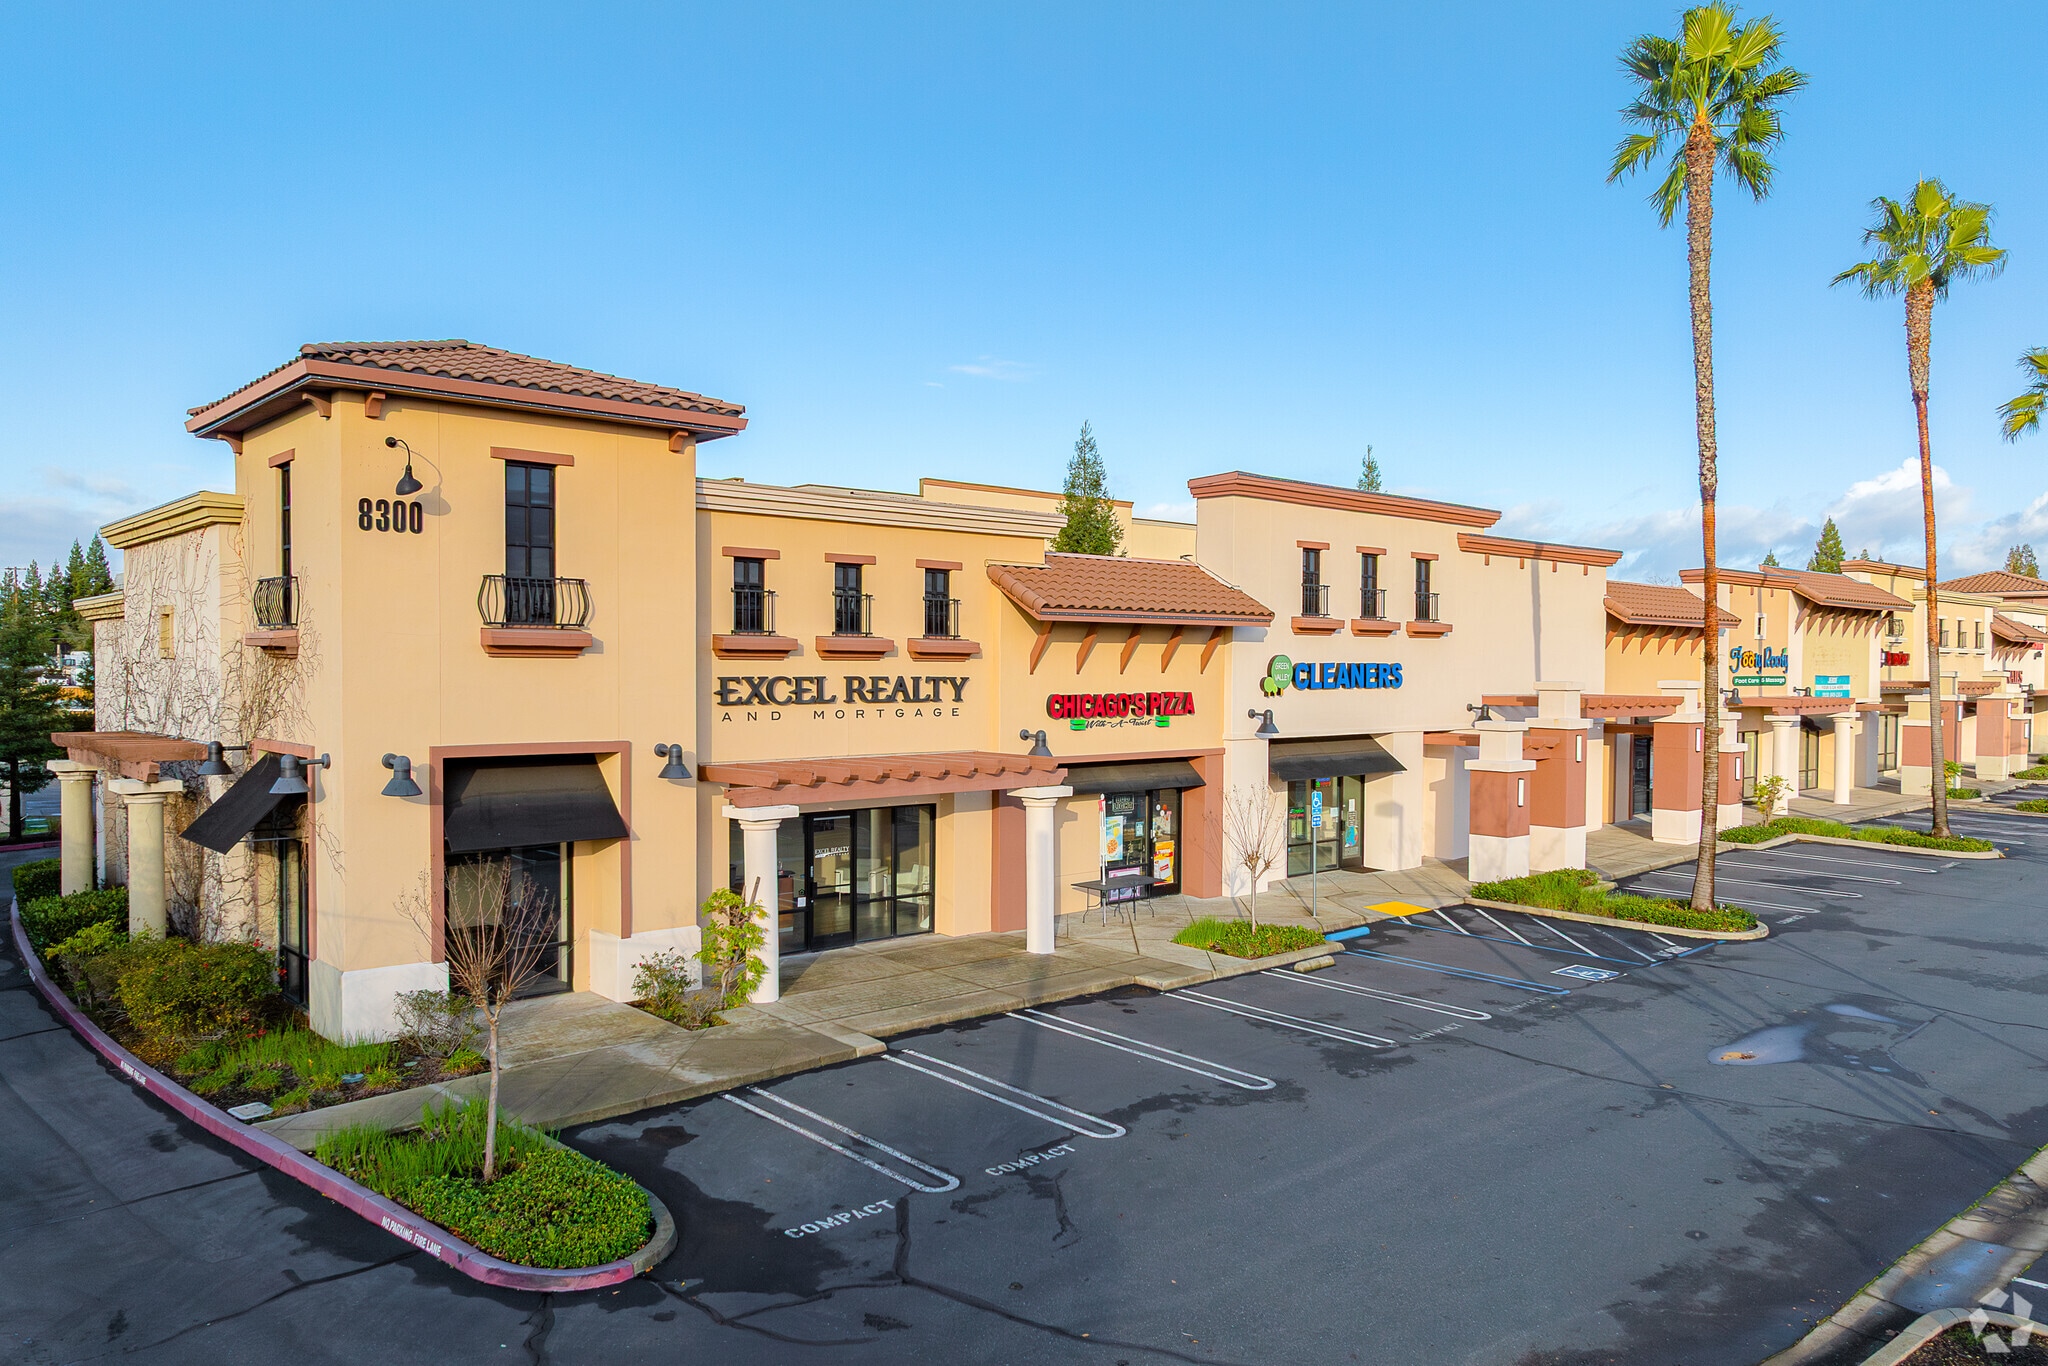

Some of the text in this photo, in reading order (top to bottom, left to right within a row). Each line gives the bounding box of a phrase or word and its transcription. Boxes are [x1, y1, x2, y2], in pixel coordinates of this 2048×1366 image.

[358, 497, 423, 535] 8300
[1275, 662, 1289, 670] GREEN
[1729, 646, 1762, 674] Footy
[713, 675, 970, 706] EXCEL REALTY
[1274, 673, 1290, 681] VALLEY
[1293, 662, 1403, 690] CLEANERS
[722, 707, 960, 722] AND MORTGAGE
[1047, 691, 1195, 720] CHICAGO'S PIZZA
[985, 1143, 1076, 1177] COMPACT
[784, 1199, 896, 1239] COMPACT
[381, 1215, 442, 1257] NO PARKING FIRE LANE
